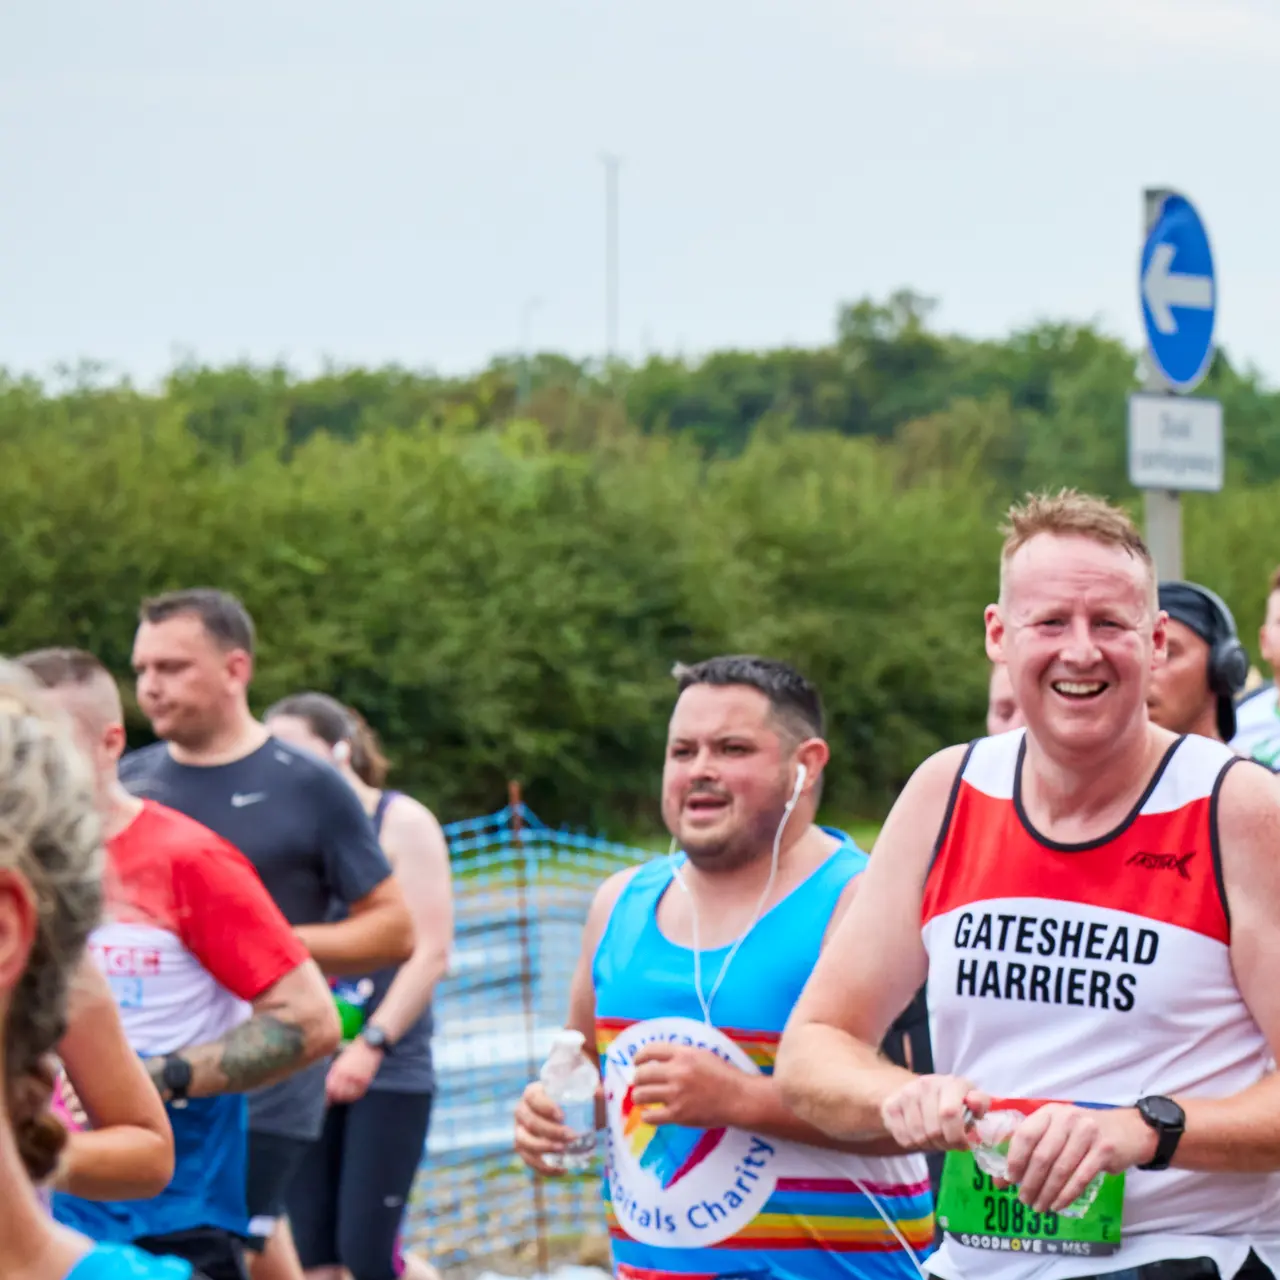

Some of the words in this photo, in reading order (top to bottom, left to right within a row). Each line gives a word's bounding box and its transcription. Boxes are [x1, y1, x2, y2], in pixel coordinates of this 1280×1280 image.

[954, 912, 1160, 965] GATESHEAD
[956, 959, 1138, 1012] HARRIERS
[686, 1135, 776, 1230] Charity
[961, 1233, 1044, 1250] GOODMOVE
